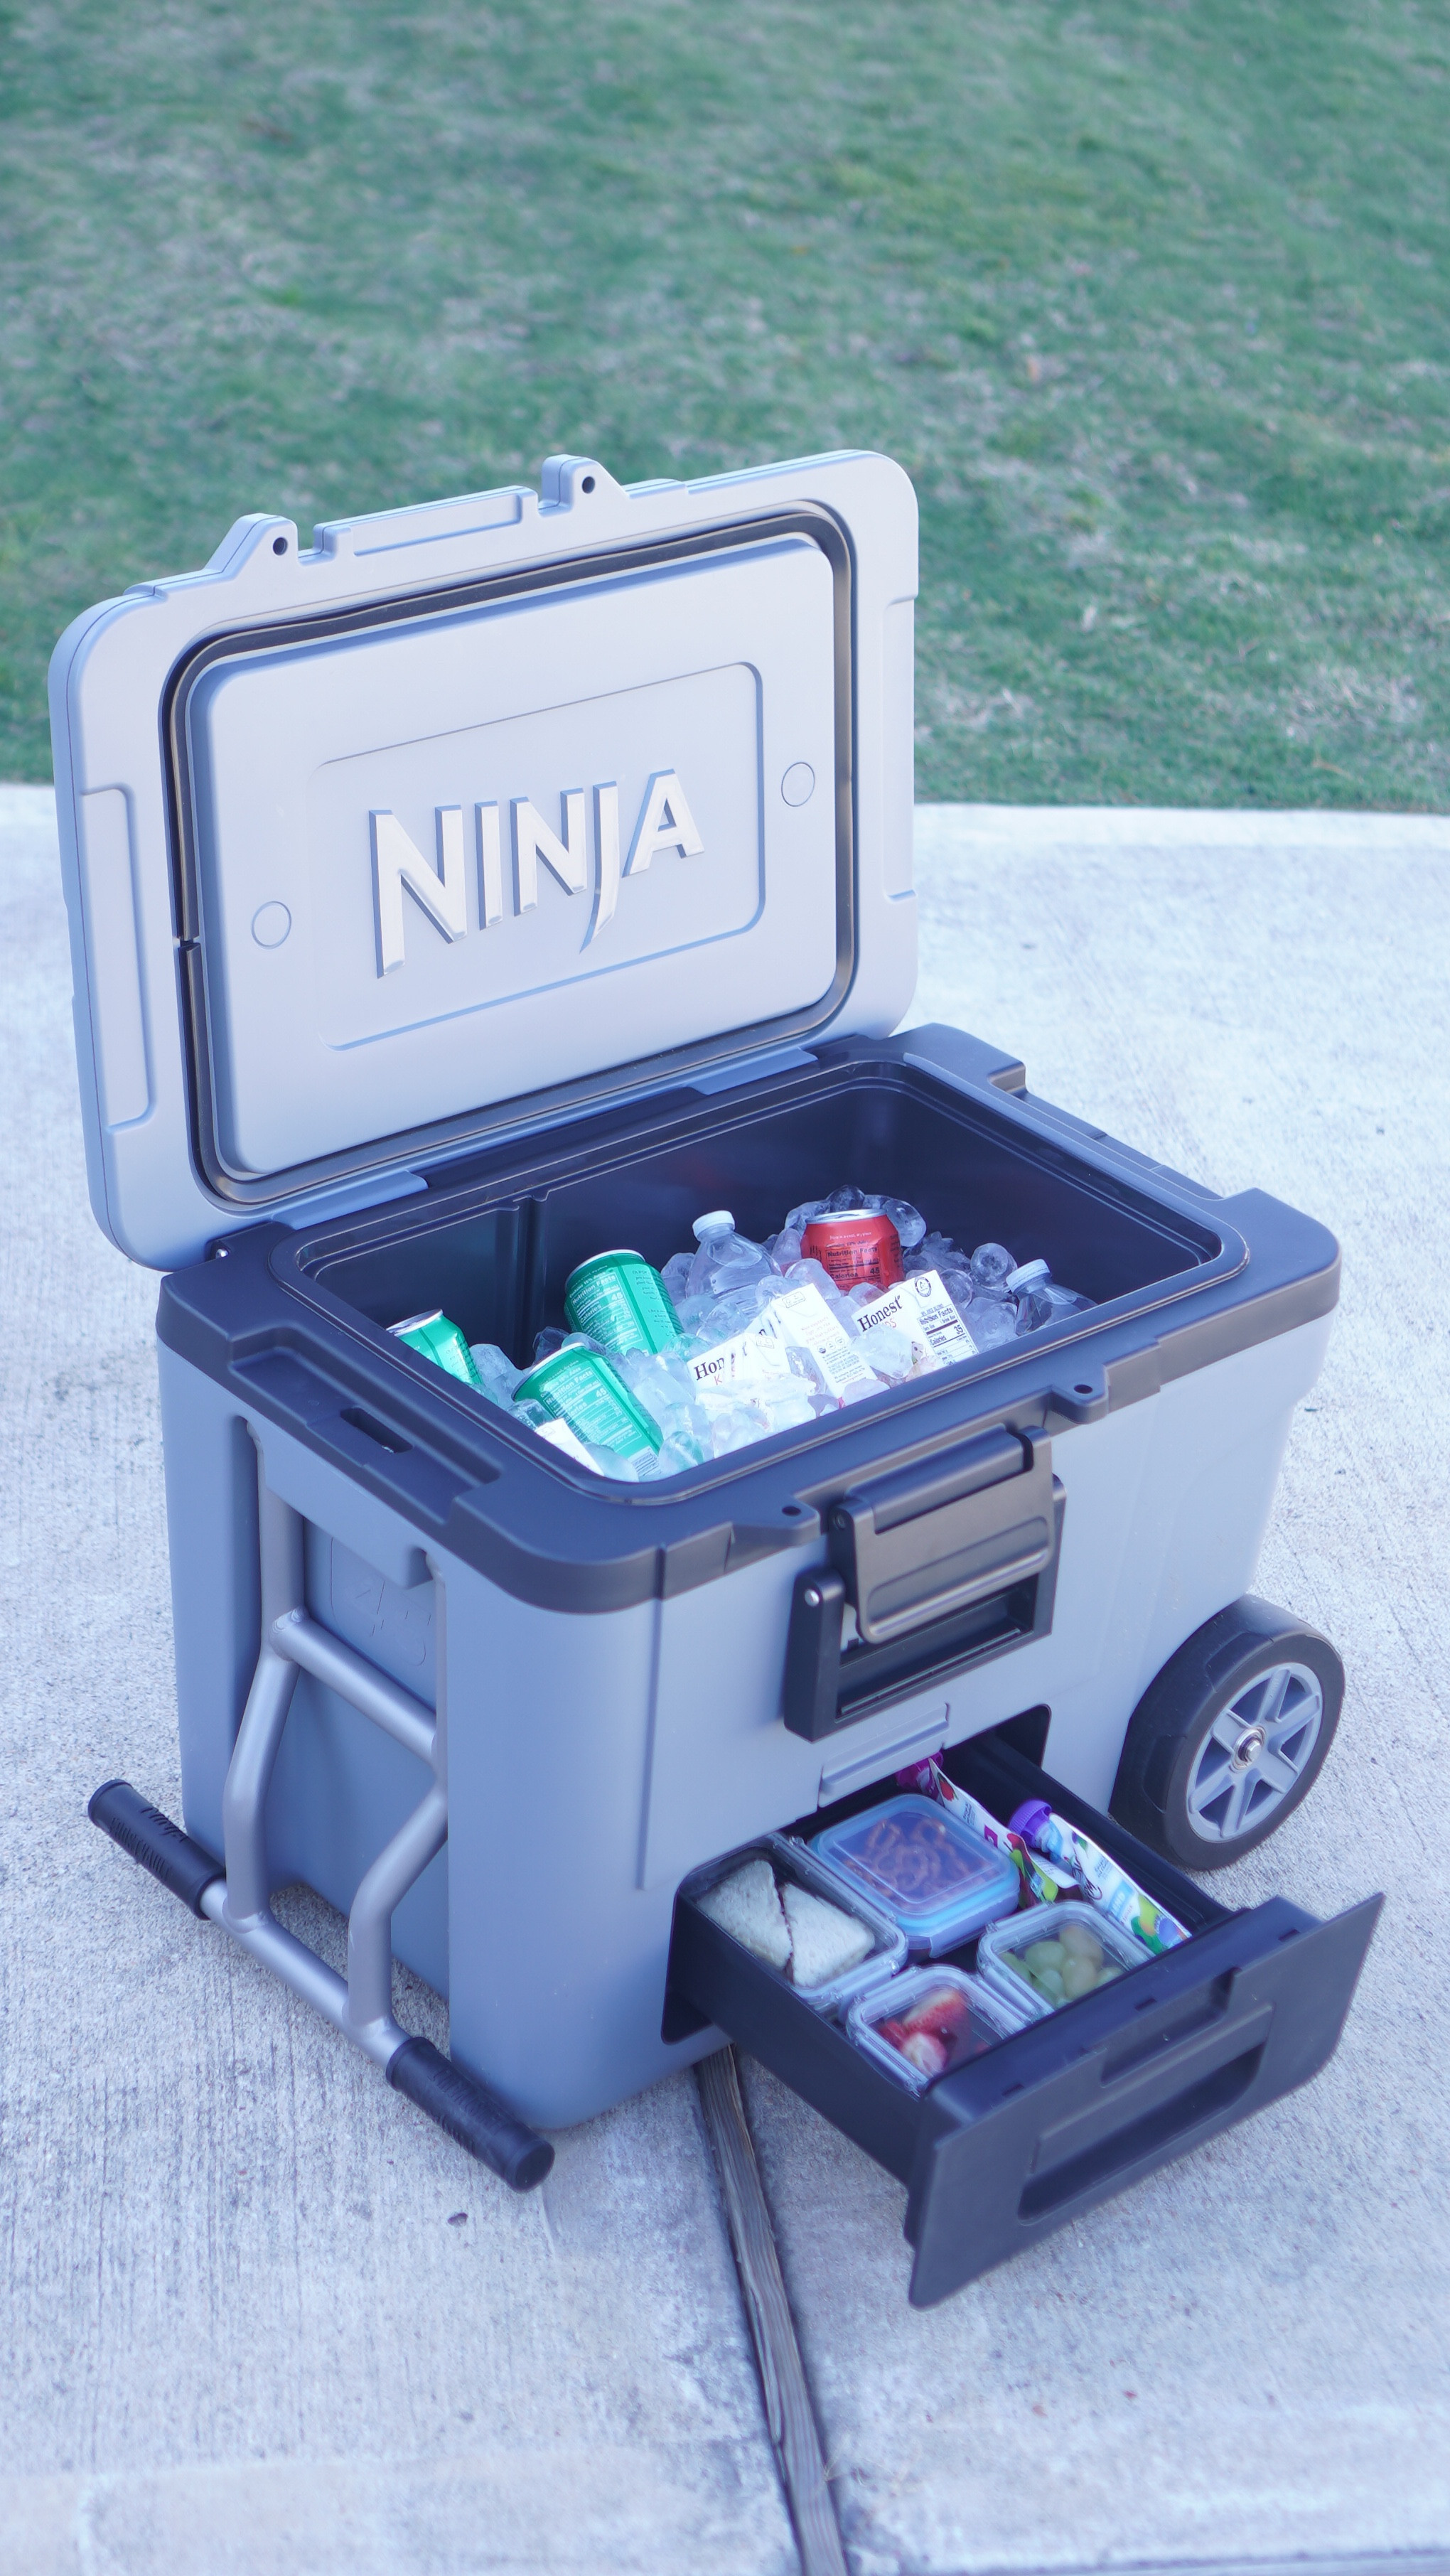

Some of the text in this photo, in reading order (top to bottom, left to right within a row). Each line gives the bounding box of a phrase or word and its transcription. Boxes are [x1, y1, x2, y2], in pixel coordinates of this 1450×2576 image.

[369, 768, 705, 979] NINJA
[572, 1284, 596, 1305] Nutrition
[596, 1275, 616, 1287] Facts
[580, 1292, 624, 1324] Calories 45
[856, 1294, 903, 1332] Honest
[938, 1307, 953, 1319] Facts
[953, 1324, 964, 1335] 35
[574, 1370, 593, 1383] Facts
[596, 1387, 607, 1398] 45
